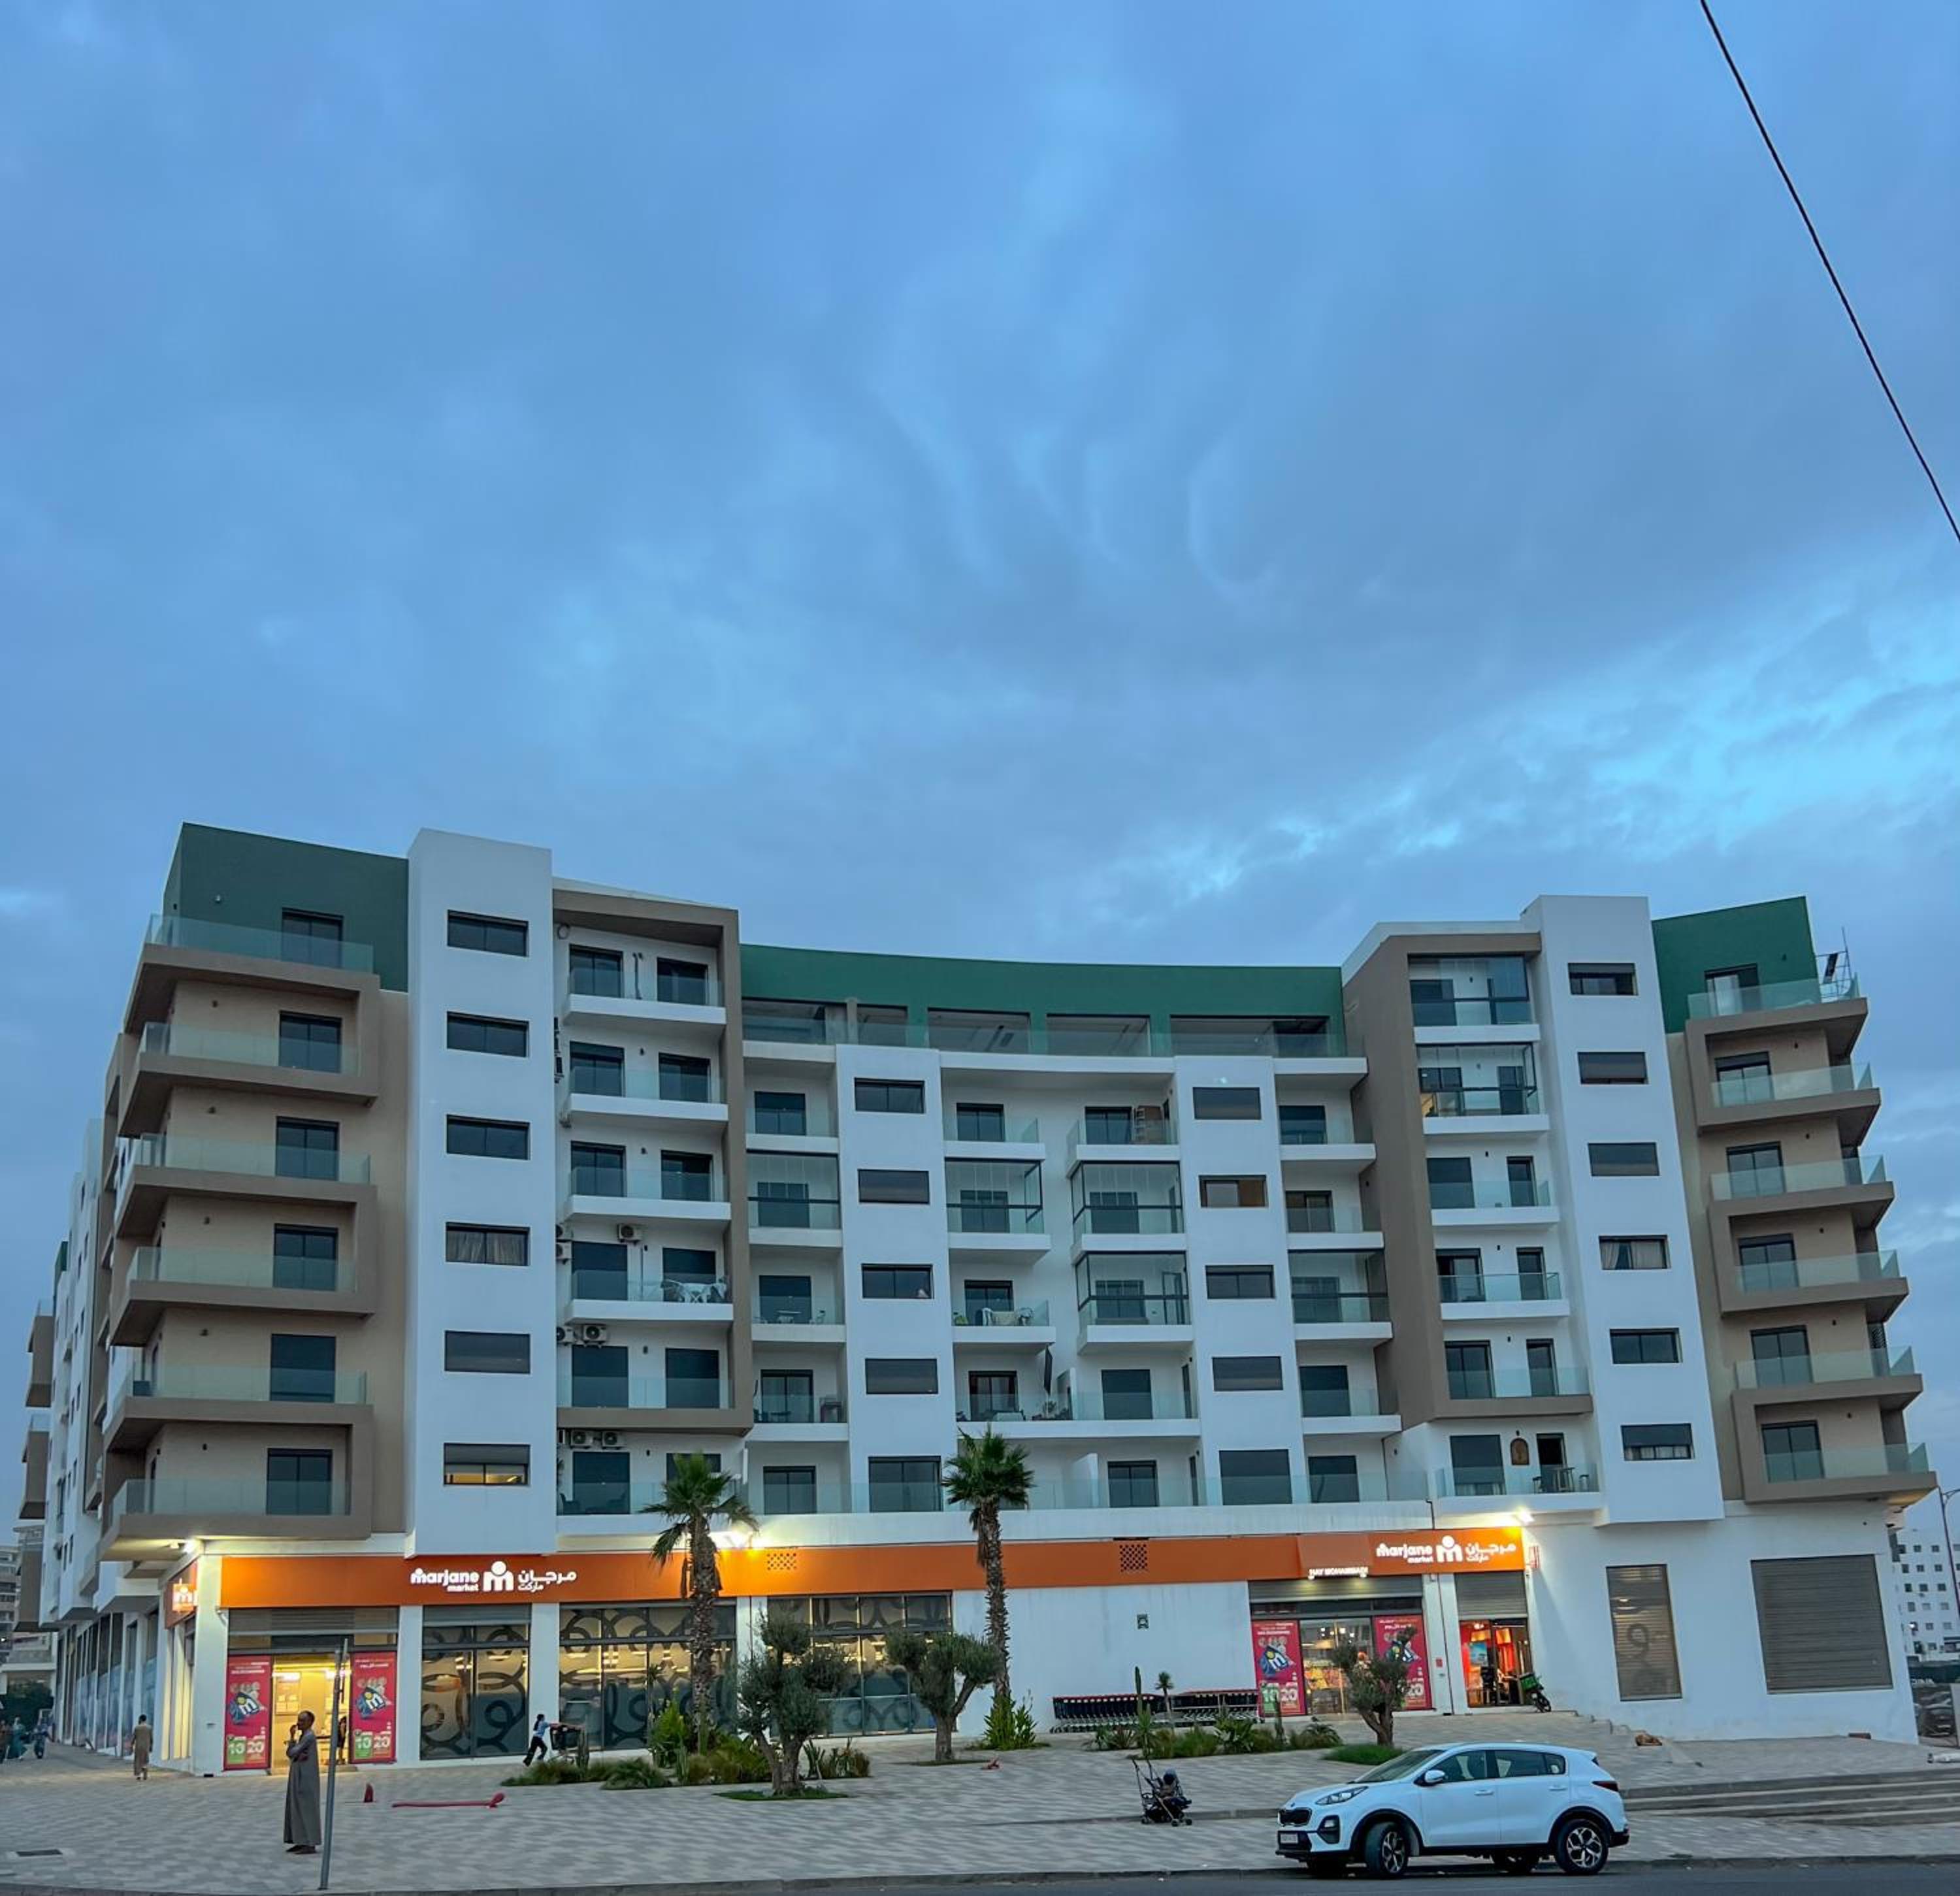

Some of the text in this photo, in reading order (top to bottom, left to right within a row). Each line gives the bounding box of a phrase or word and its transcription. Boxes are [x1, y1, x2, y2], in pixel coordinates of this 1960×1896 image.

[1377, 1543, 1433, 1558] marjane
[1465, 1543, 1516, 1554] مرجان
[410, 1568, 480, 1586] marjane
[518, 1569, 577, 1584] مرجان
